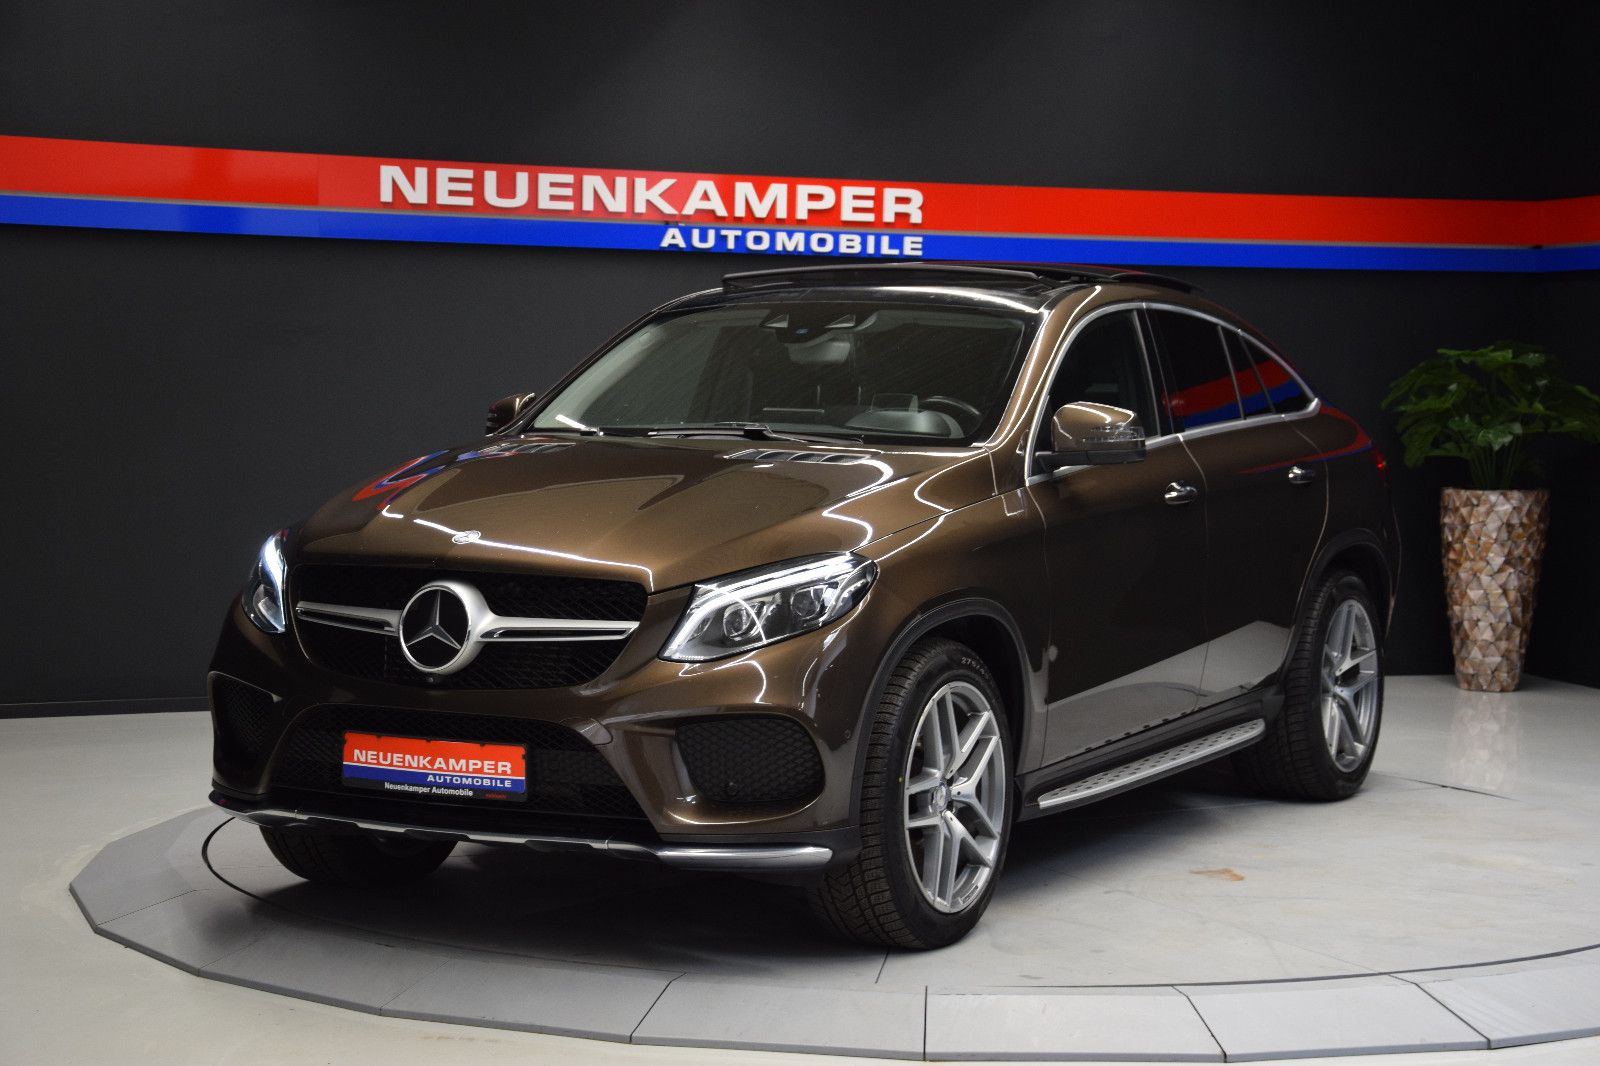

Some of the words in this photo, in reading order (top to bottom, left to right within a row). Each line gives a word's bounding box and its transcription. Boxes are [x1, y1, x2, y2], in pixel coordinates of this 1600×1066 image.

[379, 165, 924, 224] NEUENKAMPER
[660, 227, 924, 256] AUTOMOBILE
[353, 749, 512, 774] NEUENKAMPER
[384, 781, 430, 793] Neuenkamper
[432, 786, 474, 796] Automobile
[427, 774, 512, 787] AUTOMOBILE
